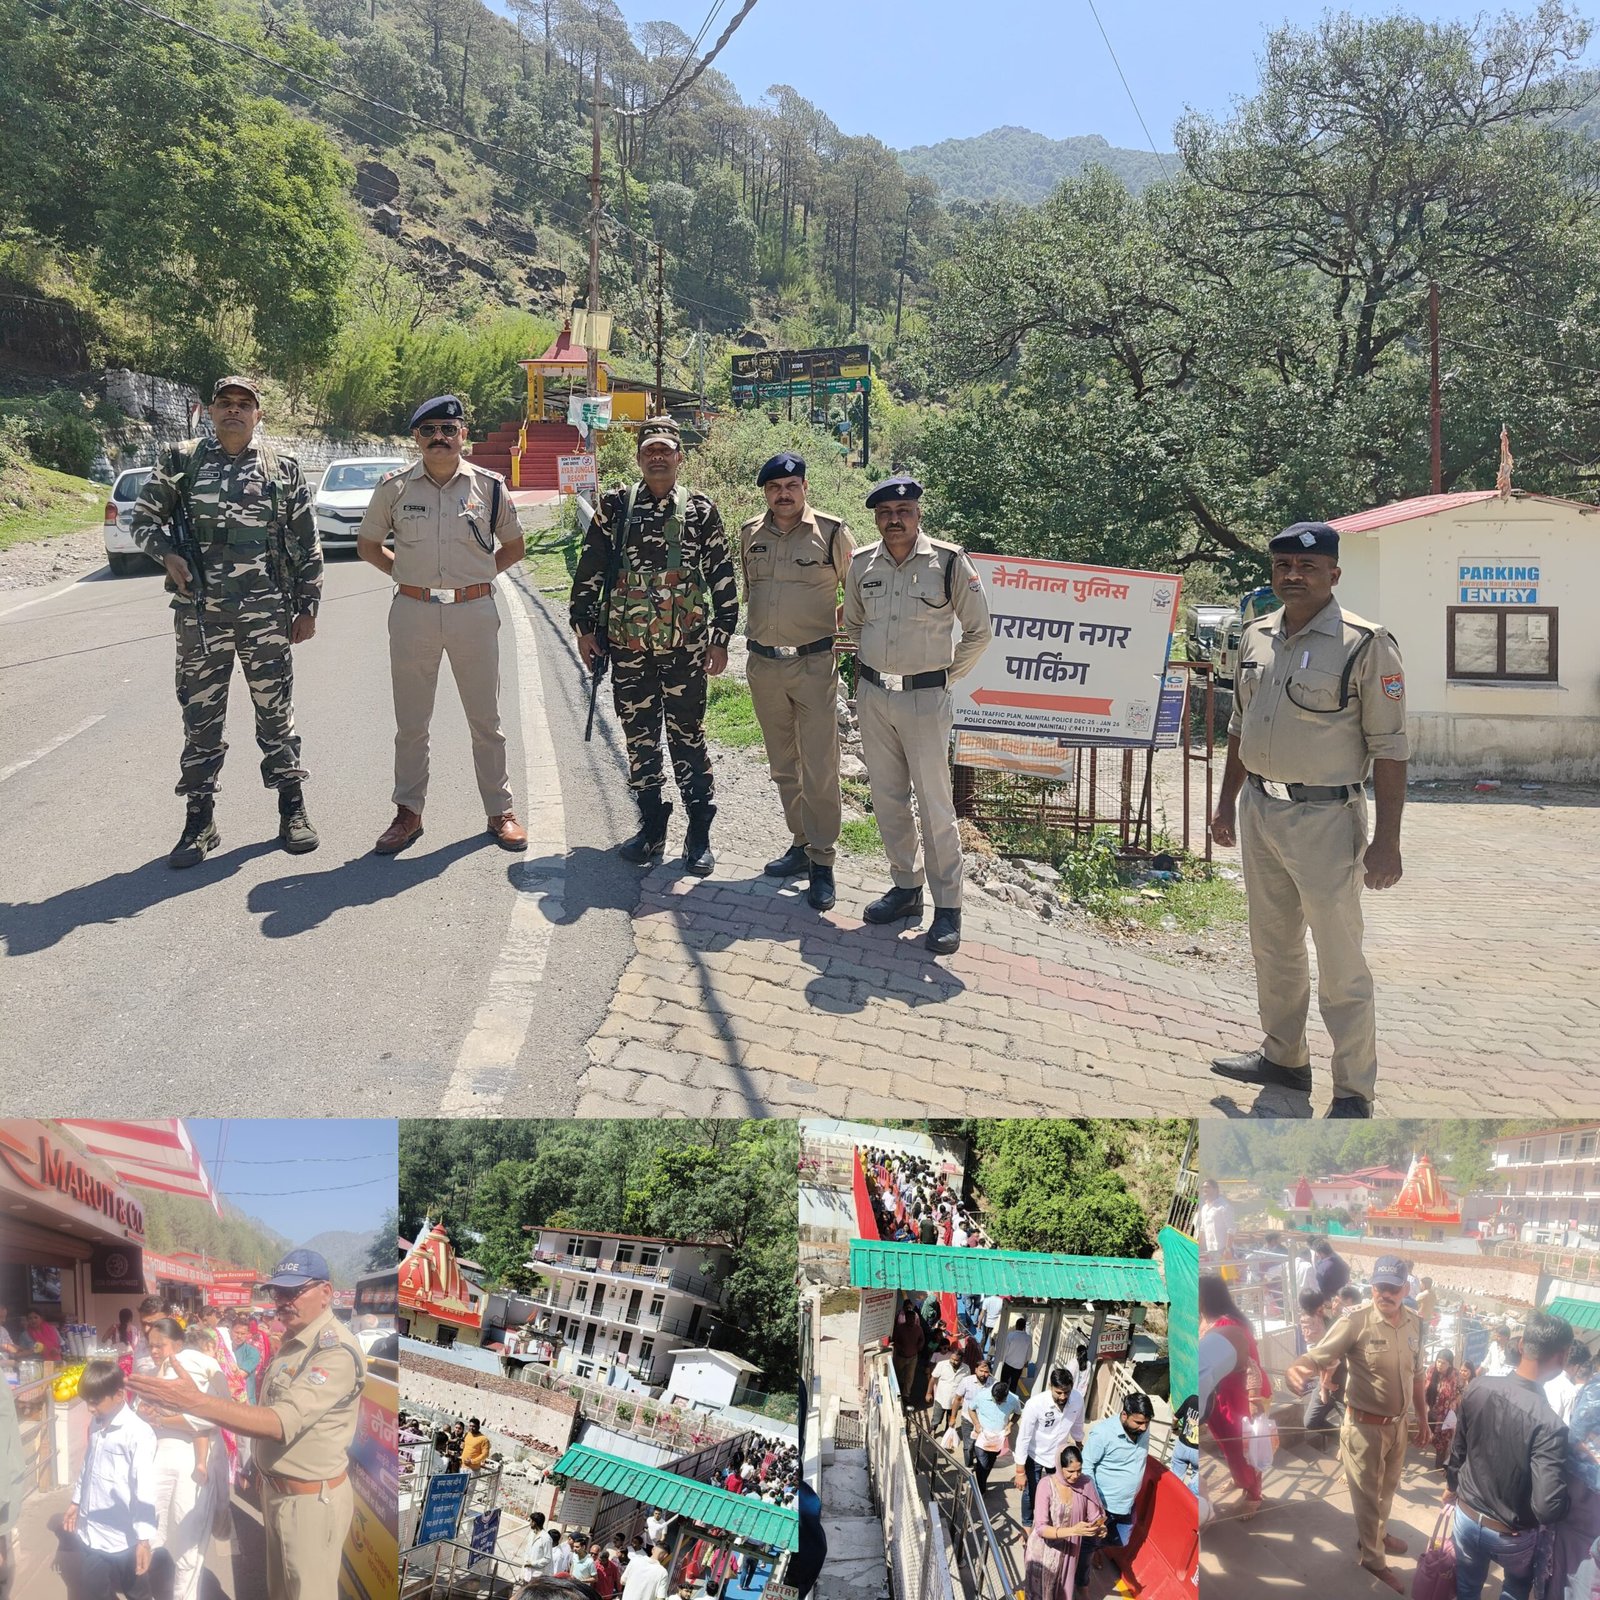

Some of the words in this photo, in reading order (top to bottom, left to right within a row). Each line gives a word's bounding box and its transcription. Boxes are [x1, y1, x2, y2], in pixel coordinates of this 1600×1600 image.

[1460, 566, 1540, 580] PARKING
[992, 565, 1069, 594] नैनीताल
[1073, 577, 1130, 603] पुलिस
[1467, 588, 1531, 602] ENTRY
[990, 613, 1075, 644] ारायण
[1079, 622, 1132, 649] नगर
[1005, 651, 1090, 685] पार्किंग
[956, 708, 980, 716] SPECIAL
[982, 710, 1005, 718] TRAFFIC
[1007, 712, 1023, 720] PLAN,
[1025, 714, 1050, 722] NAINITAL
[964, 716, 986, 724] POLICE
[987, 718, 1016, 726] CONTROL
[1017, 720, 1036, 728] ROOM
[39, 1136, 116, 1219] MARUTI
[1378, 1265, 1398, 1273] POLICE
[1100, 1333, 1126, 1342] ENTRY
[1044, 1419, 1055, 1428] 27
[767, 1583, 798, 1598] ENTRY
